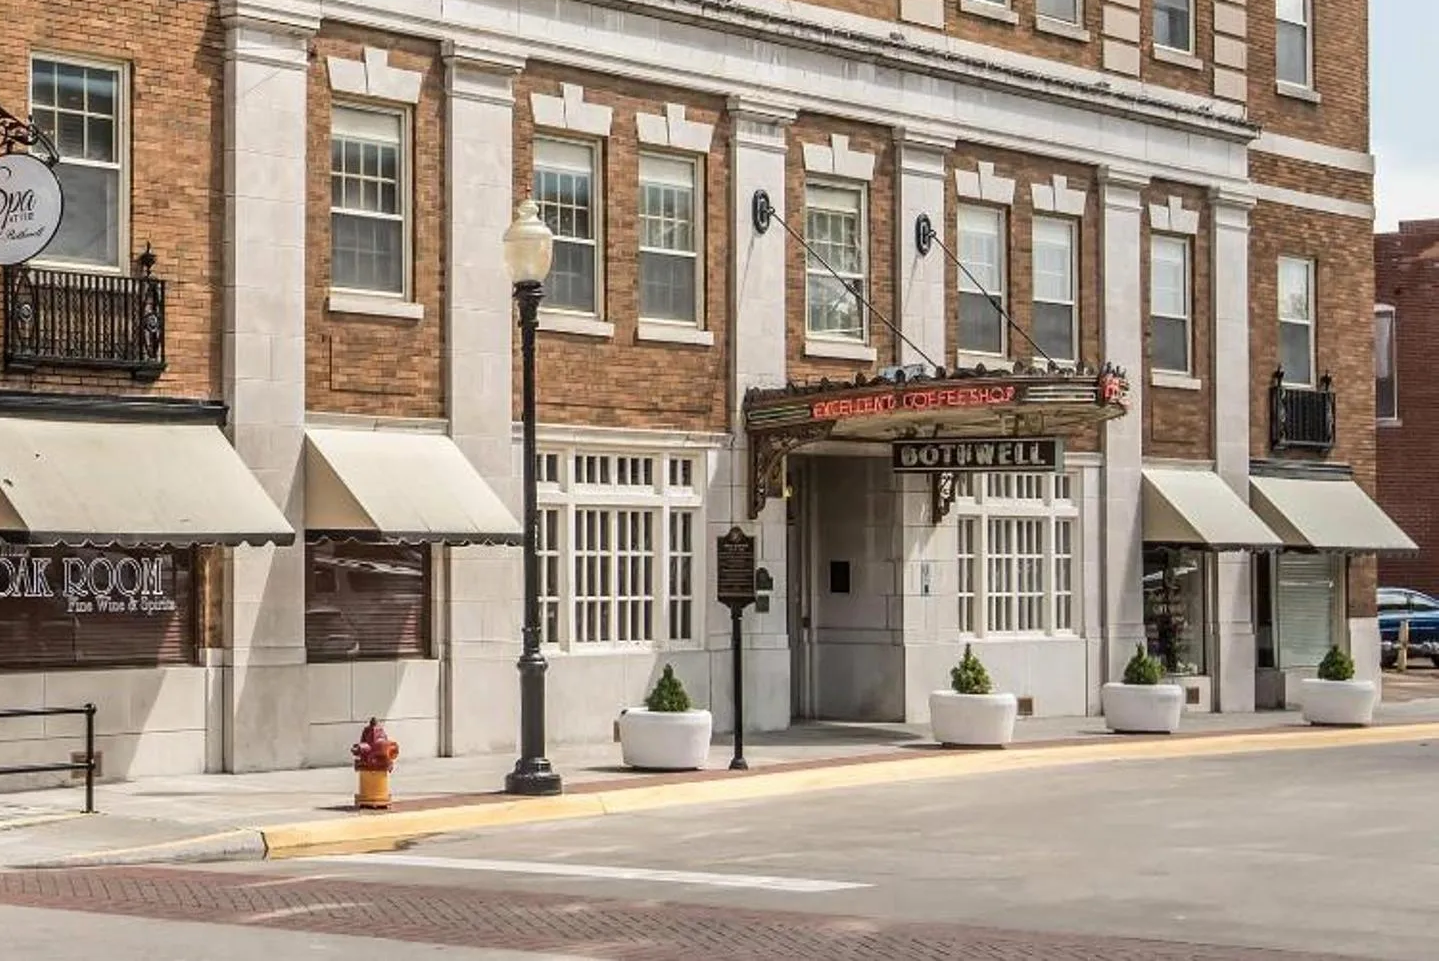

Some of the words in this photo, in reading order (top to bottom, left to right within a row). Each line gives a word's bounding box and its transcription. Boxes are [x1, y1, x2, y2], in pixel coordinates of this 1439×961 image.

[903, 389, 967, 409] COFFEE
[968, 385, 1016, 405] SHOP
[900, 441, 1046, 467] BOTHWELL
[63, 557, 164, 597] ROOM
[67, 595, 93, 612] Fine
[95, 595, 125, 612] Wine
[127, 596, 138, 612] &
[140, 595, 176, 615] Spirits
